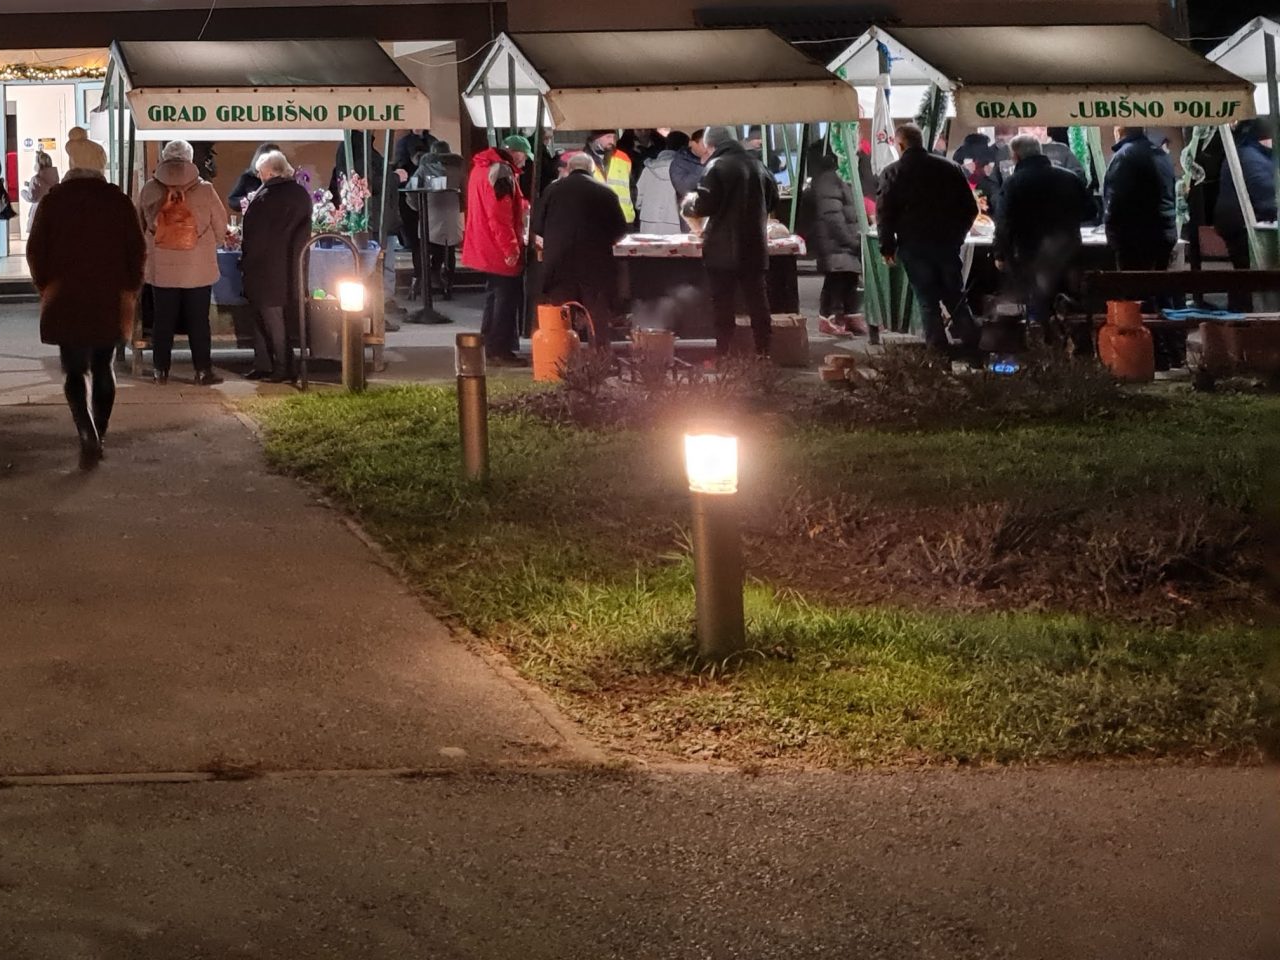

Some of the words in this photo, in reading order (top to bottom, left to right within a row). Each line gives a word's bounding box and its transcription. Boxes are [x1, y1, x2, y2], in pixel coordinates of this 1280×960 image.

[147, 105, 207, 122] GRAD
[216, 100, 328, 122] GRUBIŠNO
[337, 104, 405, 122] POLJE
[975, 101, 1037, 118] GRAD
